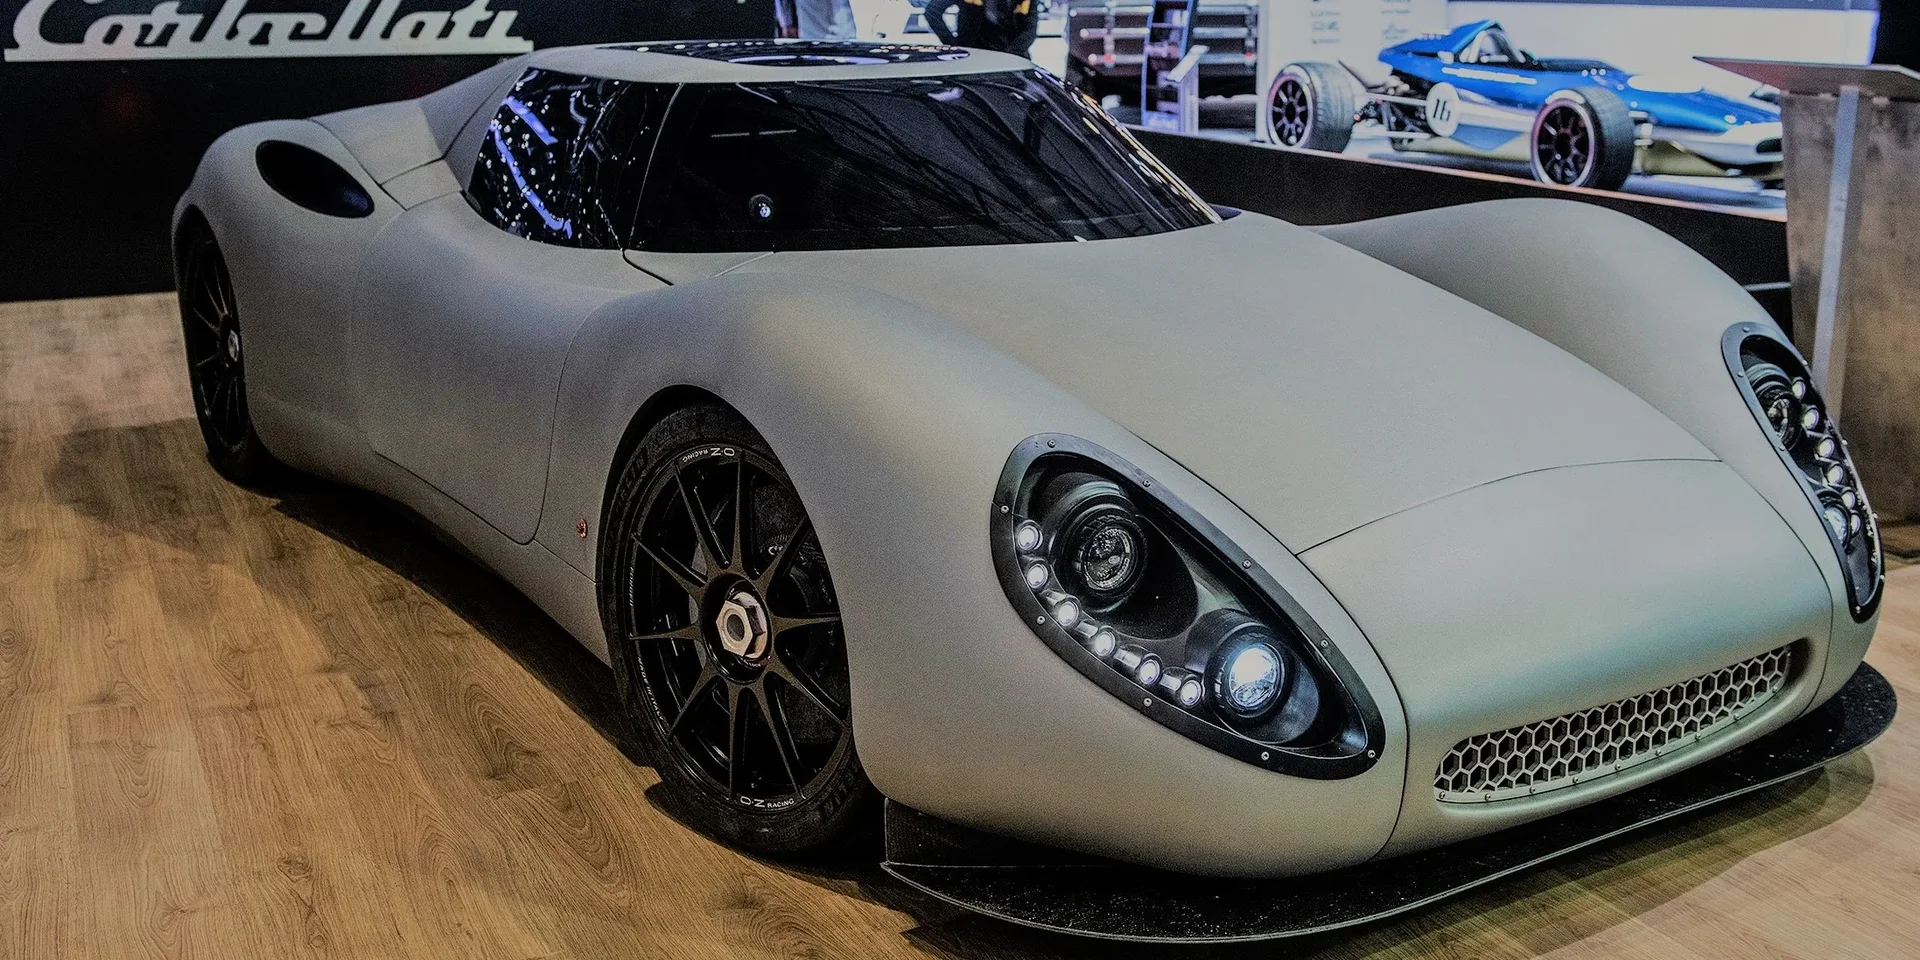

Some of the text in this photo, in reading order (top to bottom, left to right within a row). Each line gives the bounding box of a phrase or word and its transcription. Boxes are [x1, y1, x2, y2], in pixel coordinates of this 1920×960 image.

[1432, 97, 1451, 122] 16
[682, 449, 709, 463] RACING
[767, 797, 795, 809] RACING
